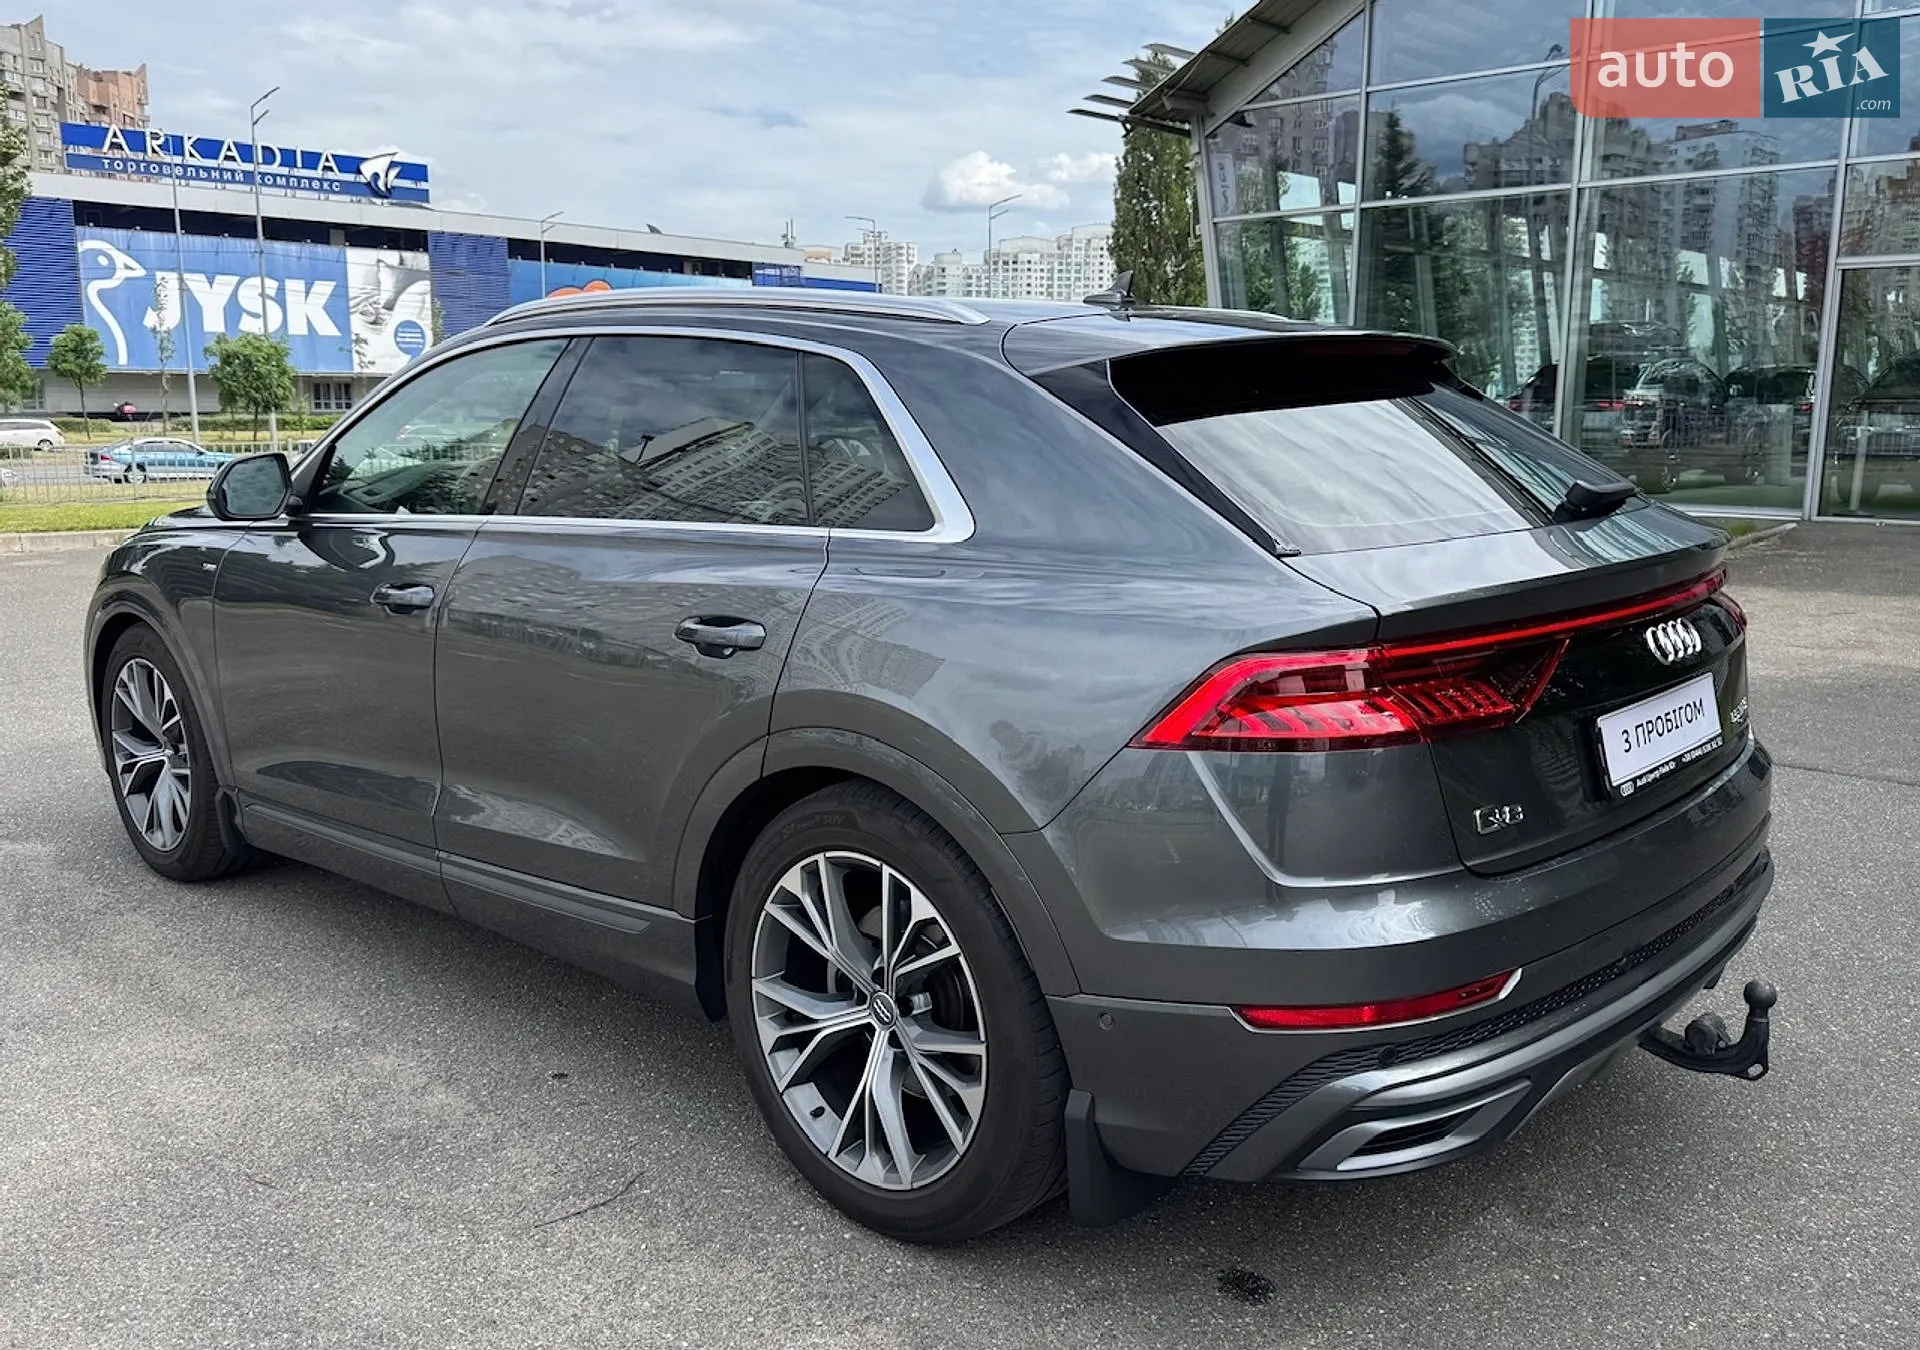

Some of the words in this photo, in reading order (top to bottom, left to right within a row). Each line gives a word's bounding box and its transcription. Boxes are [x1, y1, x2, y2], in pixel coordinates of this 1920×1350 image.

[102, 125, 341, 177] ARKADIA
[102, 158, 246, 183] торговельний
[143, 271, 342, 337] JYSK
